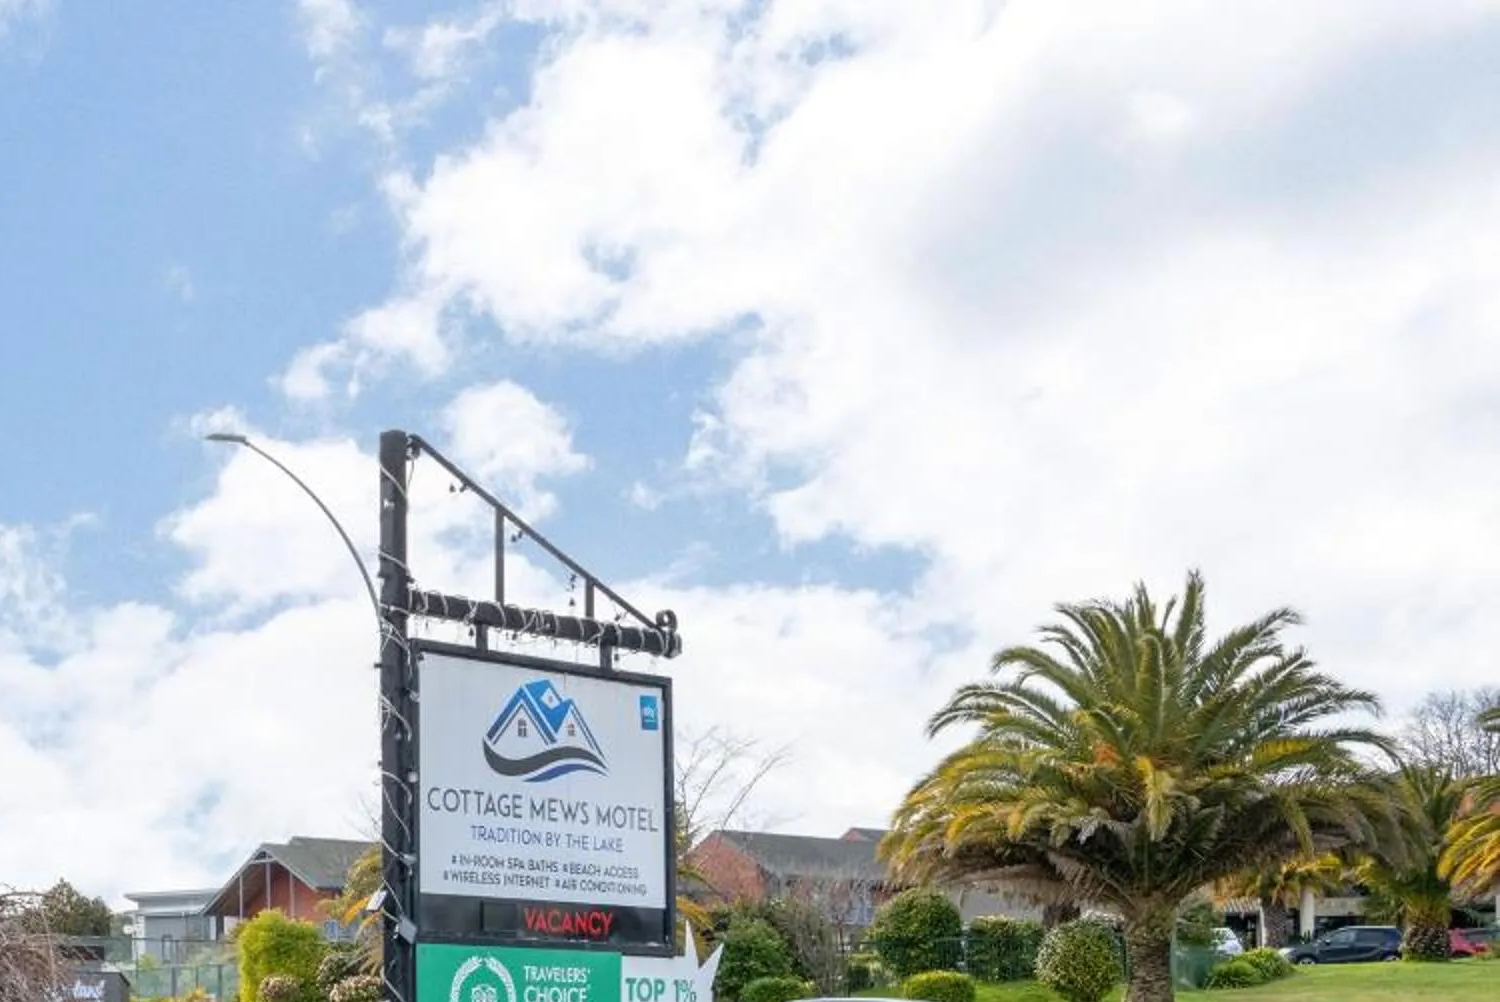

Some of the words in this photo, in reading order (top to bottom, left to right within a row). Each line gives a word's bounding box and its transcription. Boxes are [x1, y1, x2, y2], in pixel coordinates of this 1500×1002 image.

[427, 787, 523, 819] COTTAGE
[530, 797, 589, 825] MEWS
[596, 804, 659, 832] MOTEL
[471, 825, 542, 845] TRADITION
[546, 832, 560, 847] BY
[565, 833, 589, 850] THE
[593, 836, 624, 853] LAKE
[527, 859, 559, 873] BATHS
[503, 874, 549, 888] INTERNET
[524, 907, 613, 935] VACANCY
[625, 977, 666, 1002] TOP
